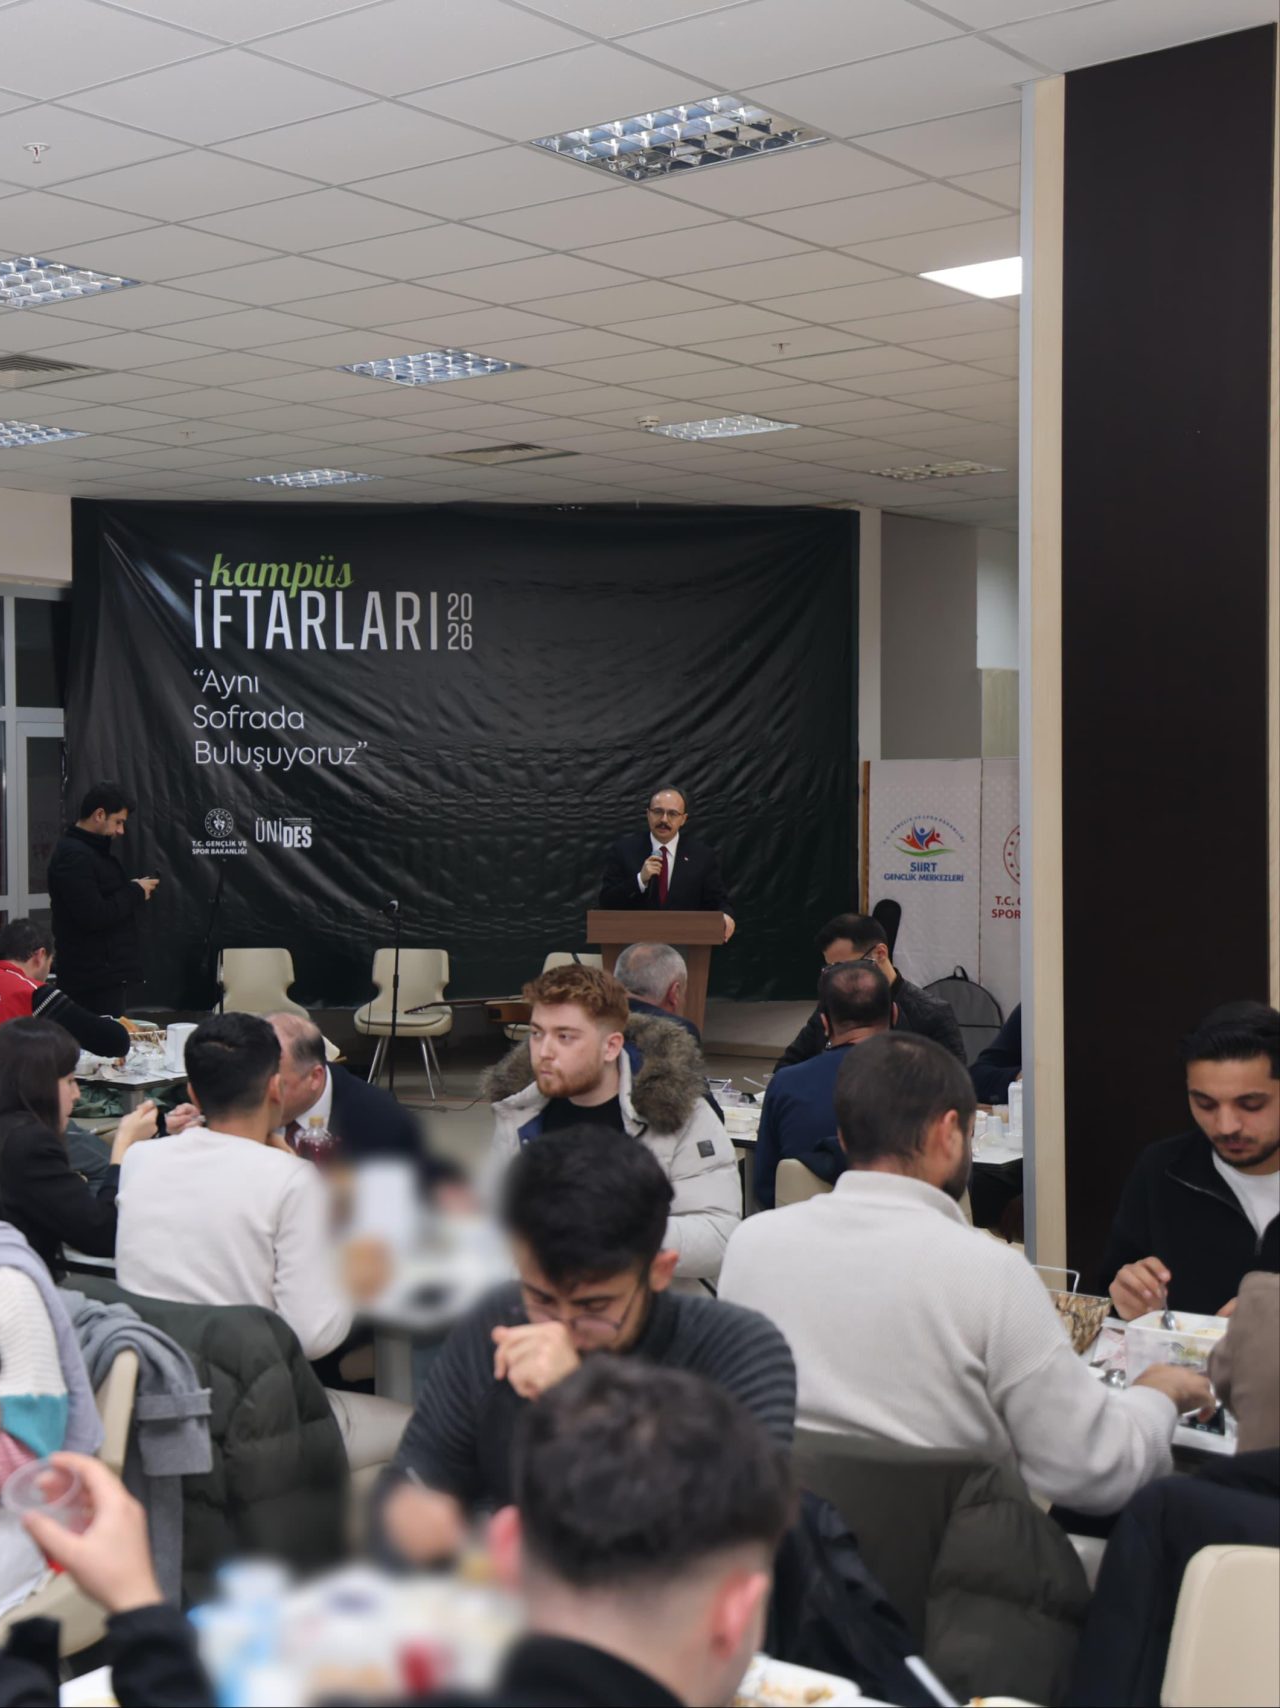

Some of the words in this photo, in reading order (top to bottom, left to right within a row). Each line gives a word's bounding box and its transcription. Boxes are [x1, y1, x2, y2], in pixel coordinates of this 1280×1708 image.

[209, 553, 355, 599] kampüs
[193, 579, 438, 651] İFTARLARI
[447, 593, 472, 621] 20
[447, 623, 473, 651] 26
[193, 704, 304, 730] Sofrada
[991, 908, 1021, 919] SPOR
[995, 895, 1014, 906] T.C.
